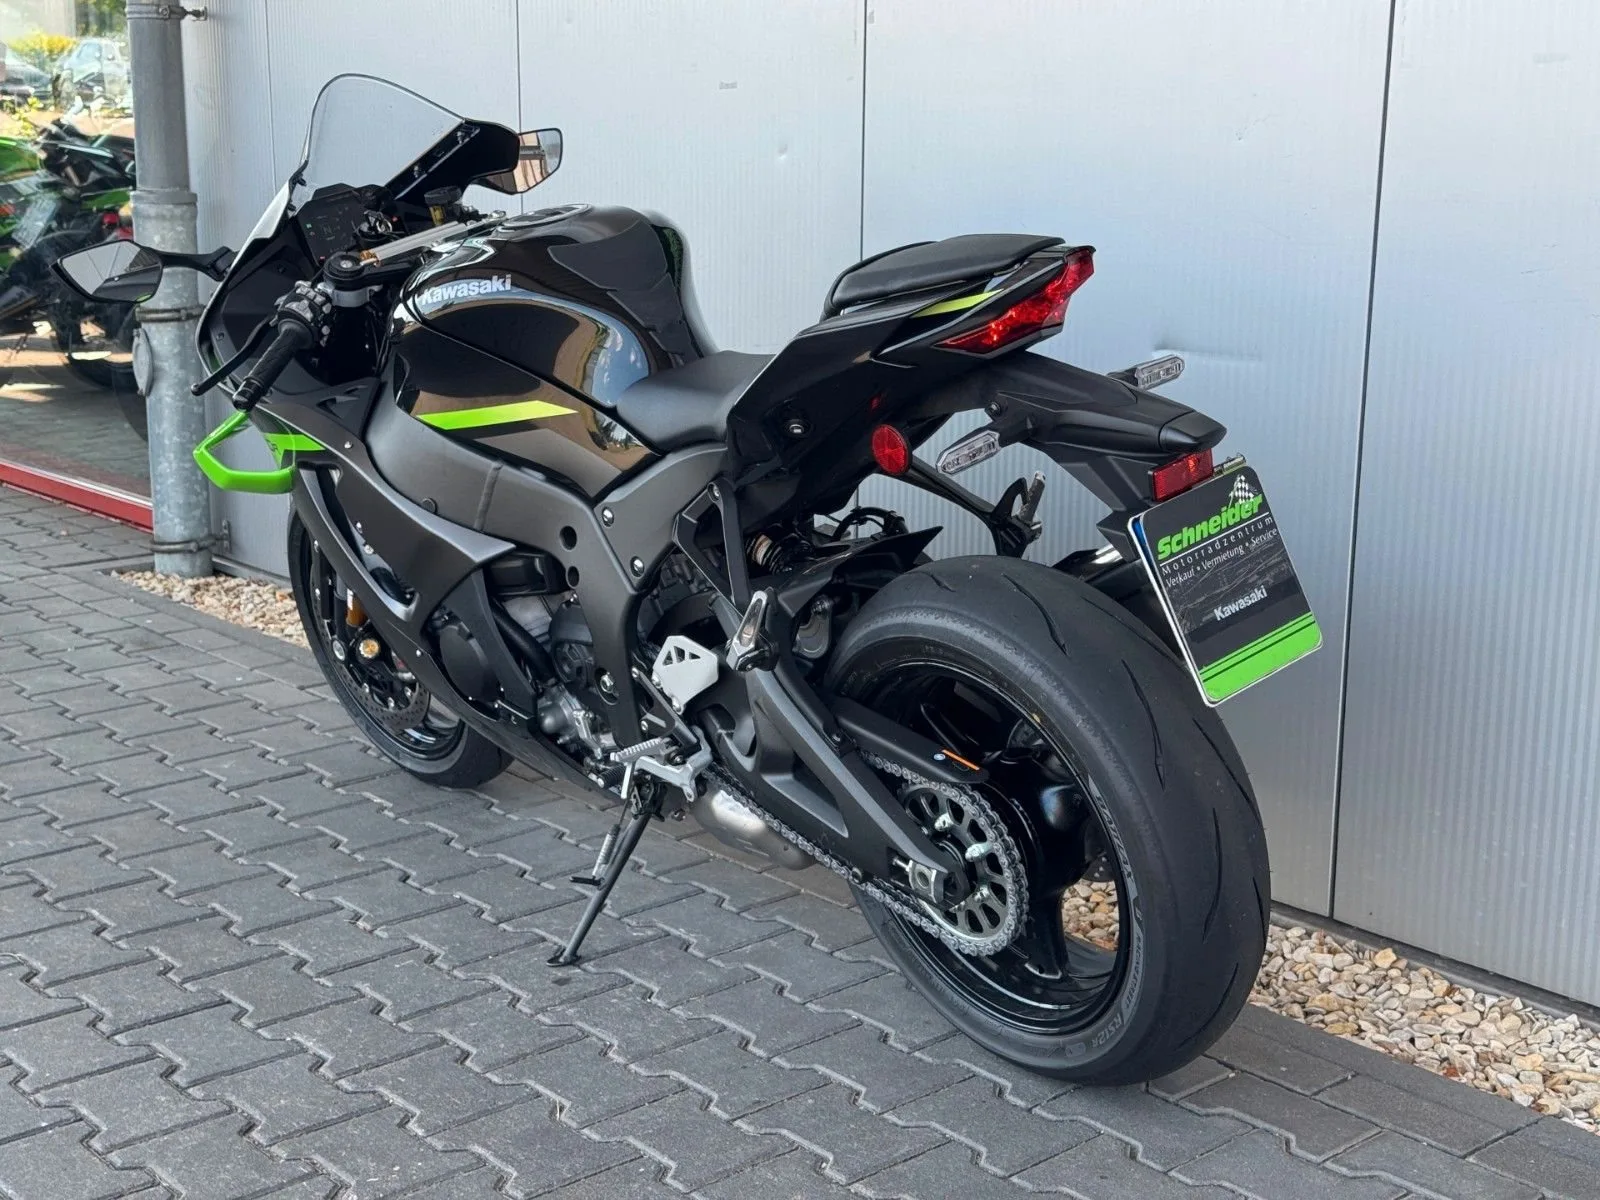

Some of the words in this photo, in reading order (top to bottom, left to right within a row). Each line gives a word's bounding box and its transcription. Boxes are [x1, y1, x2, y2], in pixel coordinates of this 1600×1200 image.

[422, 274, 512, 305] Kawasaki
[1157, 494, 1262, 560] Schneider
[1161, 517, 1273, 577] Motorradzentrum
[1166, 567, 1195, 588] Verkauf
[1201, 544, 1245, 571] Vermietung
[1250, 527, 1278, 547] Service
[1213, 585, 1268, 621] Kawasaki
